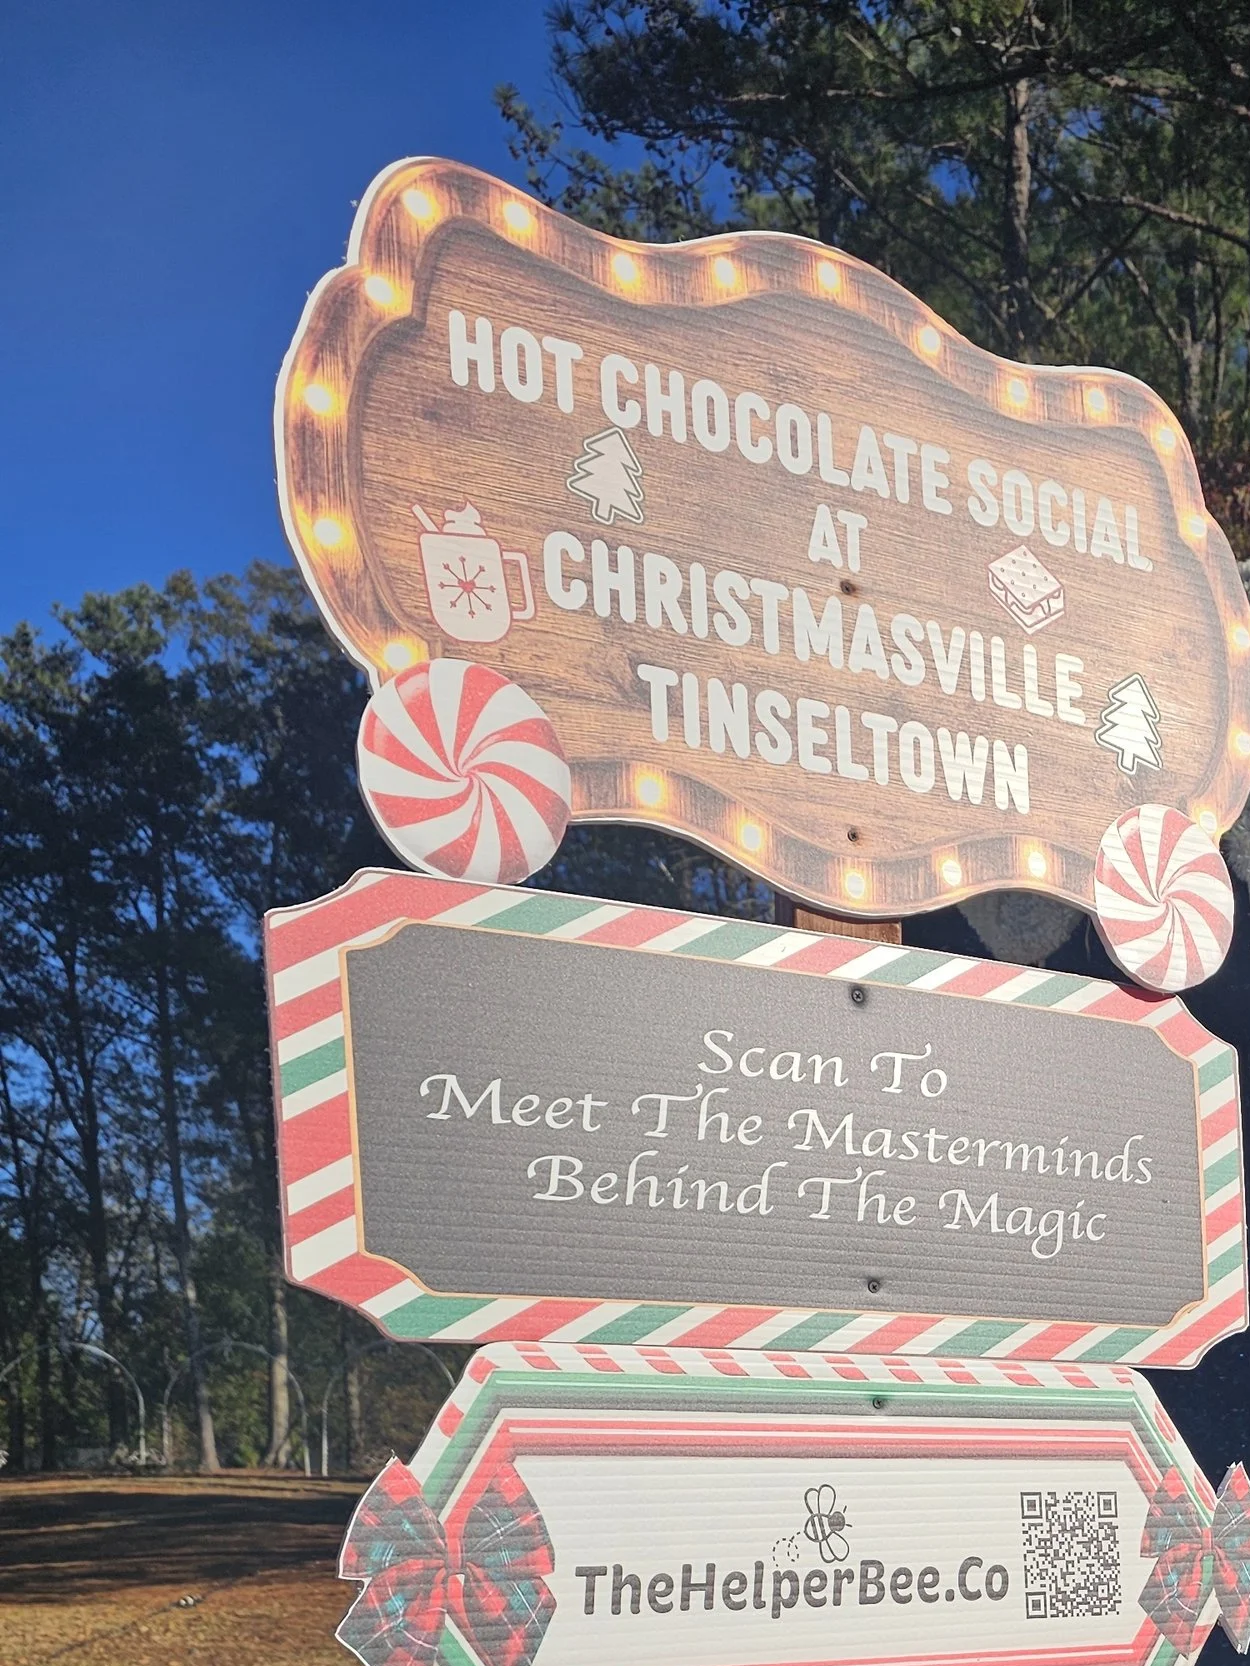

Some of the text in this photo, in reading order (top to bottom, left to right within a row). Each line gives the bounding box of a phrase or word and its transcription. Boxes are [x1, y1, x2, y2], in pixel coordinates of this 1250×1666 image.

[448, 310, 1153, 573] HOT CHOCOLATE SOCIAL
[807, 503, 868, 573] AT
[542, 531, 1087, 726] CHRISTMASVILLE
[637, 663, 1030, 815] TINSELTOWN
[697, 1029, 948, 1098] Scan To
[419, 1073, 1153, 1185] Meet The Masterminds
[527, 1150, 1108, 1260] Behind The Magic
[575, 1556, 1010, 1619] TheHelperBee.Co
